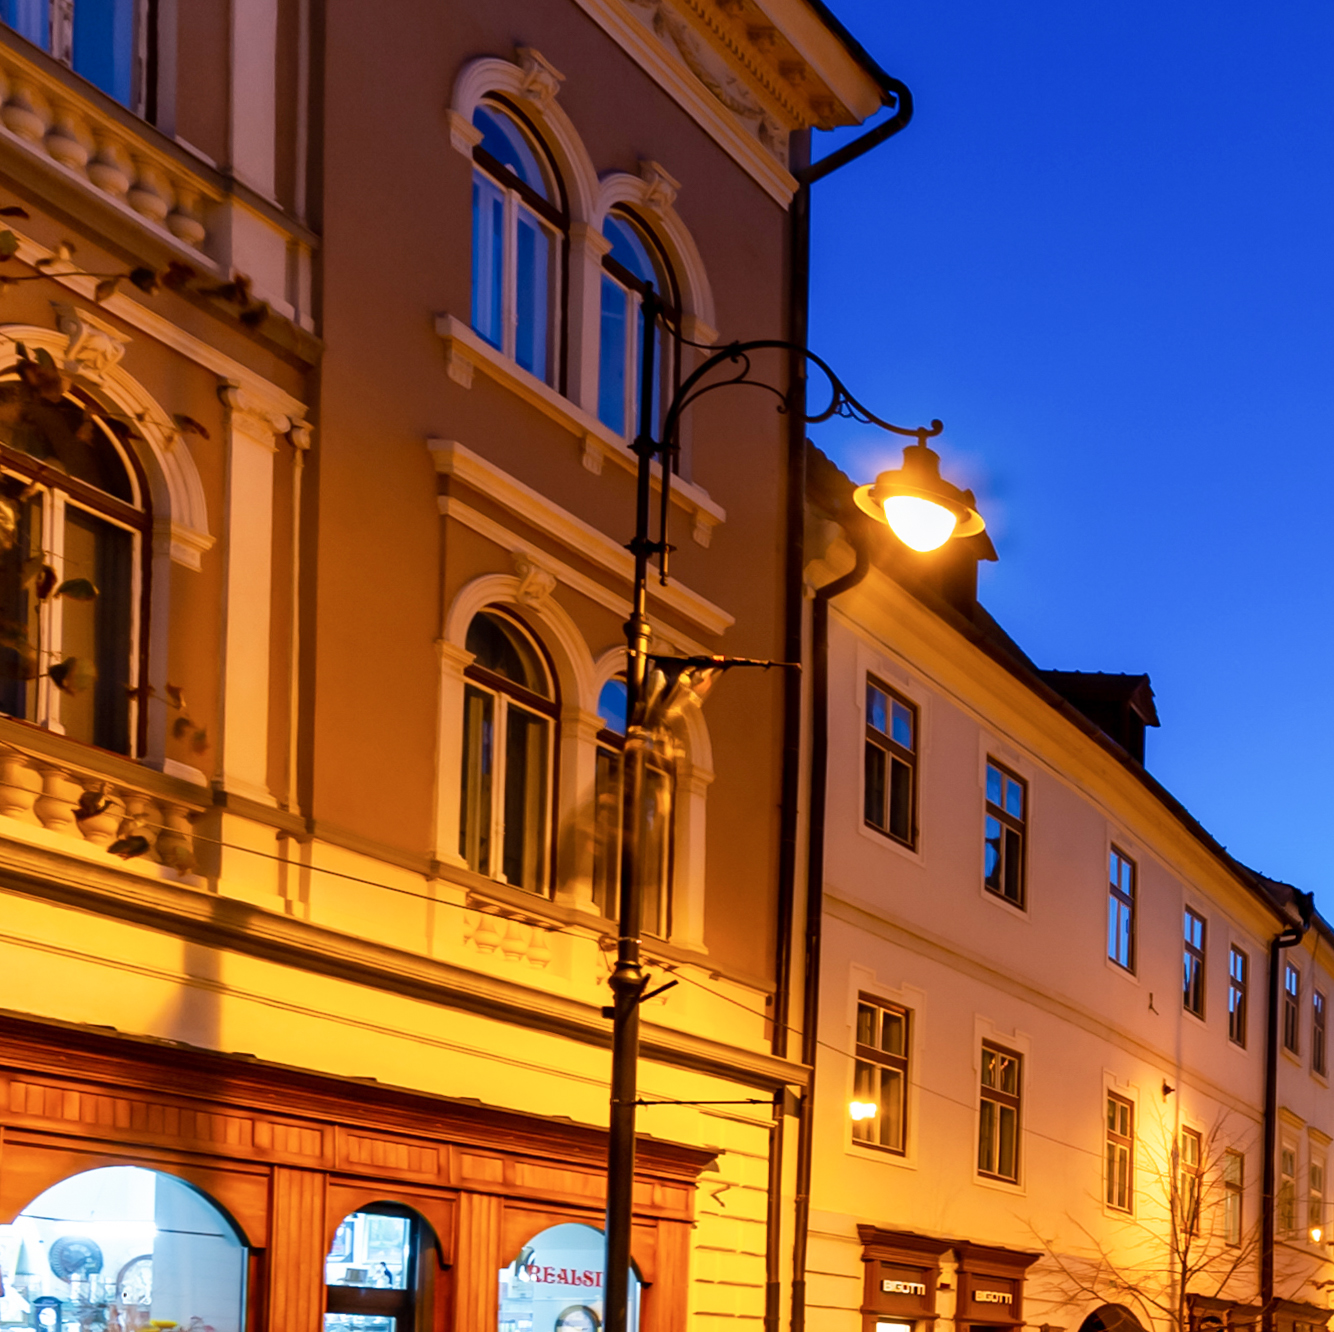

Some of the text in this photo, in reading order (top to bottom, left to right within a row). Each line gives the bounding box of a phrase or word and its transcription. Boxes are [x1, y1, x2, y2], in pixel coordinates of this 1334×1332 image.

[527, 1264, 604, 1287] REALSI
[883, 1279, 926, 1295] BIGOTTI
[975, 1290, 1013, 1304] BIGOTTI
